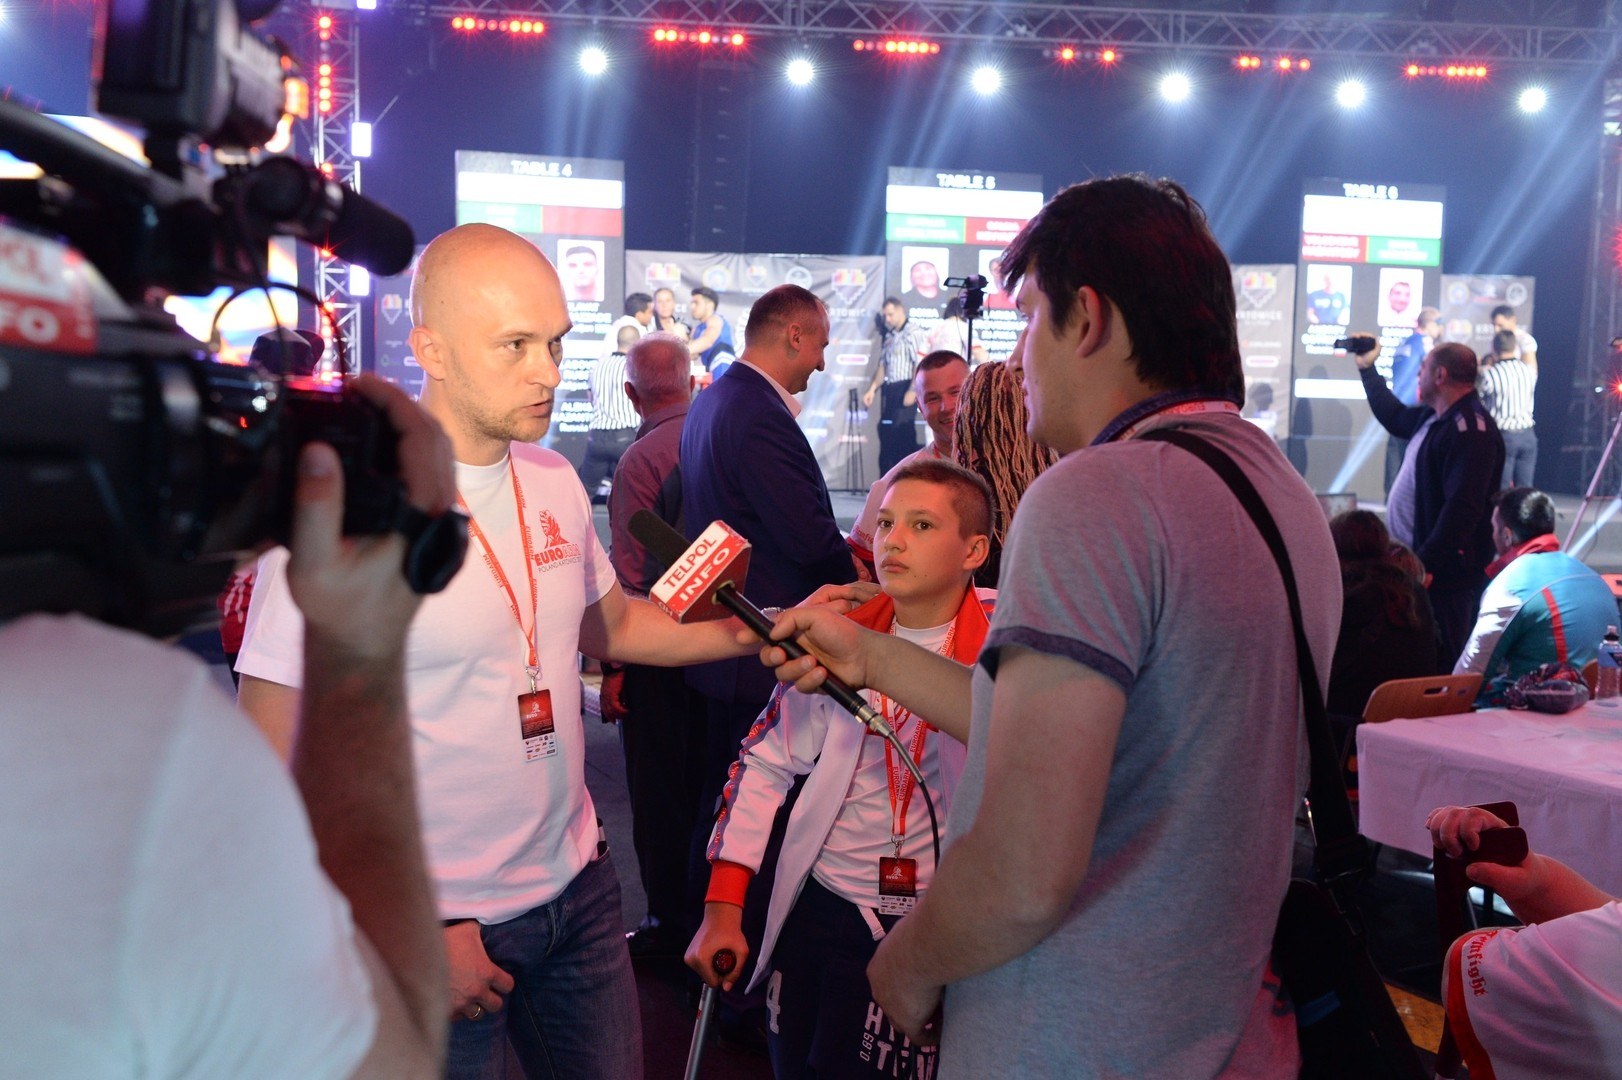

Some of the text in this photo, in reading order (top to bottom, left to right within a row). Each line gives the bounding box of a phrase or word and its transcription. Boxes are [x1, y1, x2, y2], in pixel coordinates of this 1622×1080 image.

[511, 160, 573, 177] TABLE 4
[937, 173, 984, 188] TABLE
[1343, 183, 1387, 199] TABLE
[663, 539, 717, 588] TELPOL
[679, 547, 730, 602] INFO
[909, 720, 923, 753] EUROARM
[898, 768, 911, 801] EUROARM
[859, 1032, 876, 1062] 0.89
